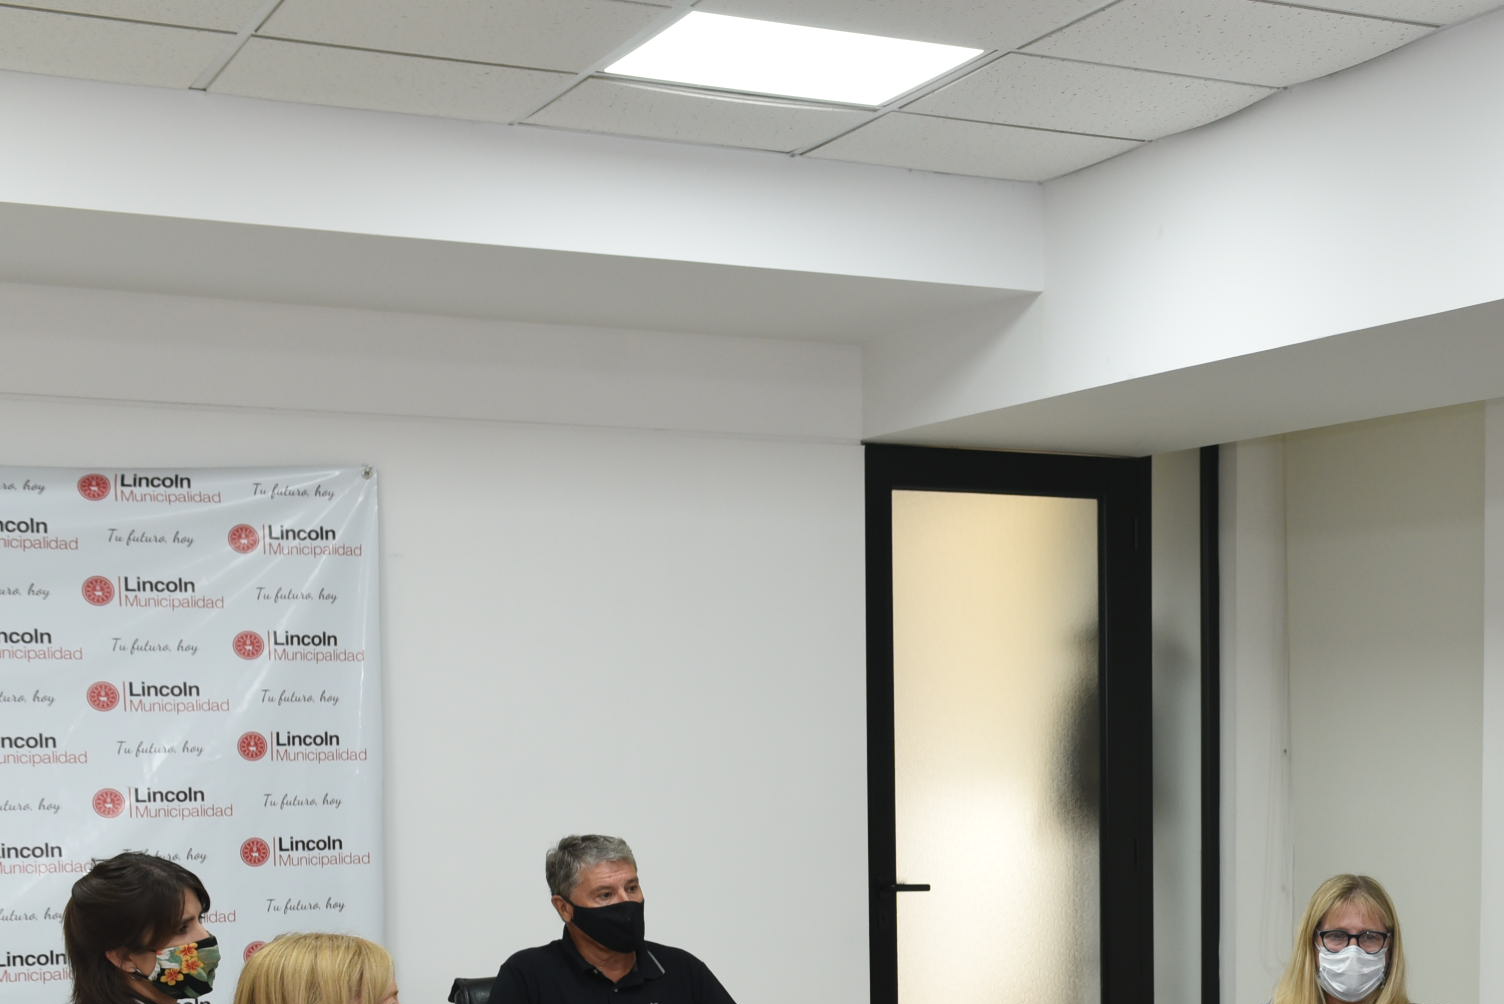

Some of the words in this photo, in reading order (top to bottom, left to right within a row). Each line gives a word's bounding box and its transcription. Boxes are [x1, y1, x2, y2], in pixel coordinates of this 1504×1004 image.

[23, 479, 46, 495] hoy
[120, 473, 191, 489] Lincoln
[120, 490, 222, 504] Municipalidad
[252, 483, 267, 497] Tu
[315, 482, 335, 499] hoy
[0, 517, 48, 534] coln
[268, 524, 336, 541] Lincoln
[0, 537, 79, 552] nicipalidad
[107, 528, 123, 543] Tu
[173, 530, 195, 547] hoy
[268, 542, 362, 558] Municipalidad
[27, 582, 50, 600] hoy
[124, 576, 195, 593] Lincoln
[125, 595, 225, 611] Municipalidad
[256, 587, 271, 601] Tu
[319, 588, 338, 604] hoy
[0, 628, 52, 644] ncoln
[273, 630, 338, 647] Lincoln
[0, 646, 83, 662] nicipalidad
[112, 637, 126, 652] Tu
[177, 638, 198, 655] hoy
[274, 648, 365, 664] Municipalidad
[33, 689, 54, 706] hoy
[129, 681, 200, 698] Lincoln
[261, 689, 275, 702] Tu
[320, 689, 339, 705] hoy
[130, 700, 230, 715] Municipalidad
[0, 733, 57, 749] ncoln
[276, 731, 340, 748] Lincoln
[116, 740, 130, 755] Tu
[182, 741, 204, 758] hoy
[276, 748, 367, 764] Municipalidad
[0, 751, 88, 766] unicipalidad
[134, 787, 205, 803] Lincoln
[263, 794, 277, 808] Tu
[322, 793, 342, 809] hoy
[38, 797, 61, 814] hoy
[135, 804, 233, 821] Municipalidad
[0, 843, 62, 859] incoln
[278, 836, 344, 852] Lincoln
[185, 847, 207, 864] hoy
[278, 852, 371, 868] Municipalidad
[0, 860, 92, 876] unicipalidad
[266, 899, 280, 913] Tu
[326, 899, 346, 915] hoy
[0, 967, 73, 985] Municipali
